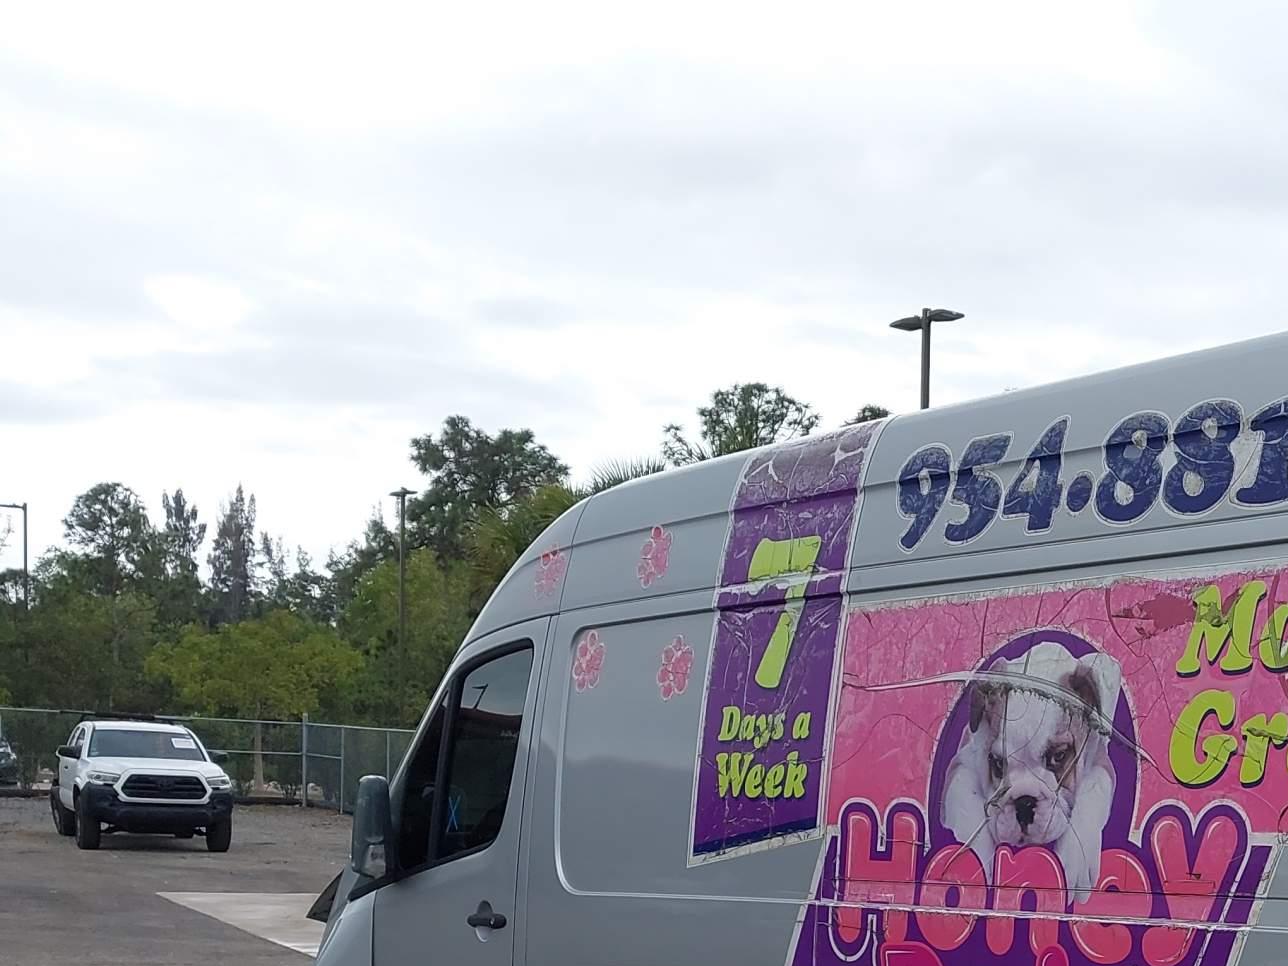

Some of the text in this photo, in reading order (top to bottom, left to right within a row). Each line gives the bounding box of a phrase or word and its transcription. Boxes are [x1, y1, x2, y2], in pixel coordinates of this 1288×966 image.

[747, 534, 822, 689] 7
[718, 705, 811, 749] Days a
[715, 752, 808, 799] Week
